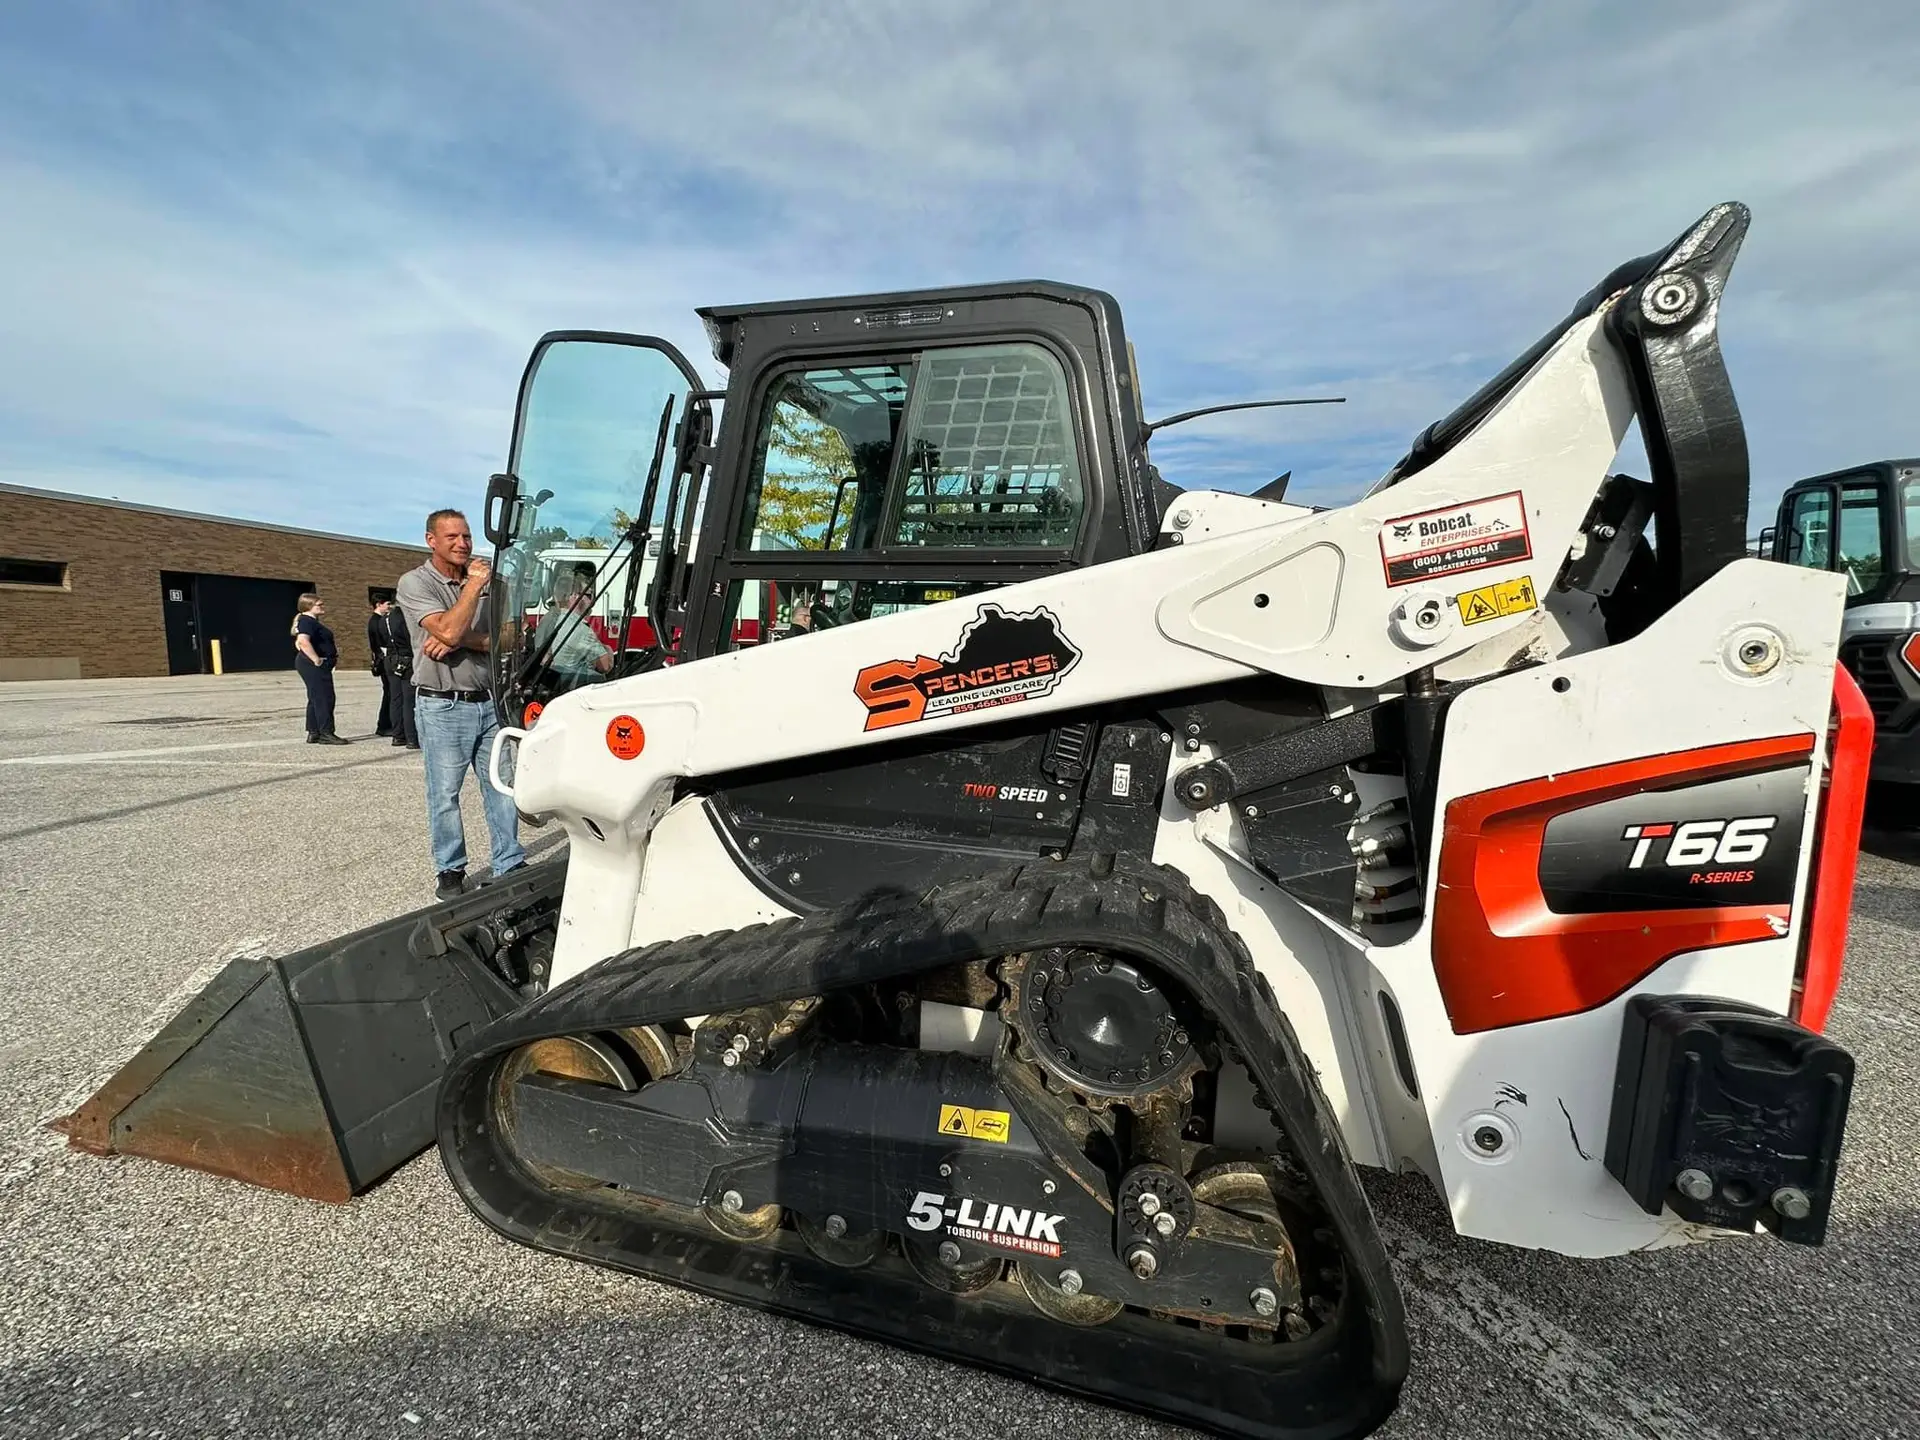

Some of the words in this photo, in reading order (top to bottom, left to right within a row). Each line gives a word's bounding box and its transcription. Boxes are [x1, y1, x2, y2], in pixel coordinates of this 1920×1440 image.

[1419, 513, 1472, 537] Bobcat
[1420, 525, 1492, 547] ENTERPRISES
[1412, 554, 1441, 570] (800)
[1444, 541, 1500, 561] 4-BOBCAT
[1428, 556, 1487, 574] BOBCATENT.COM
[932, 693, 979, 708] LEADING
[982, 686, 1011, 698] LAND
[1013, 679, 1044, 692] CARE
[964, 783, 997, 799] TWO
[999, 786, 1048, 803] SPEED
[1624, 816, 1777, 869] T66
[1689, 870, 1755, 884] R-SERIES
[906, 1191, 1065, 1243] 5-LINK
[946, 1225, 989, 1242] TORSION
[992, 1233, 1058, 1256] SUSPENSION
